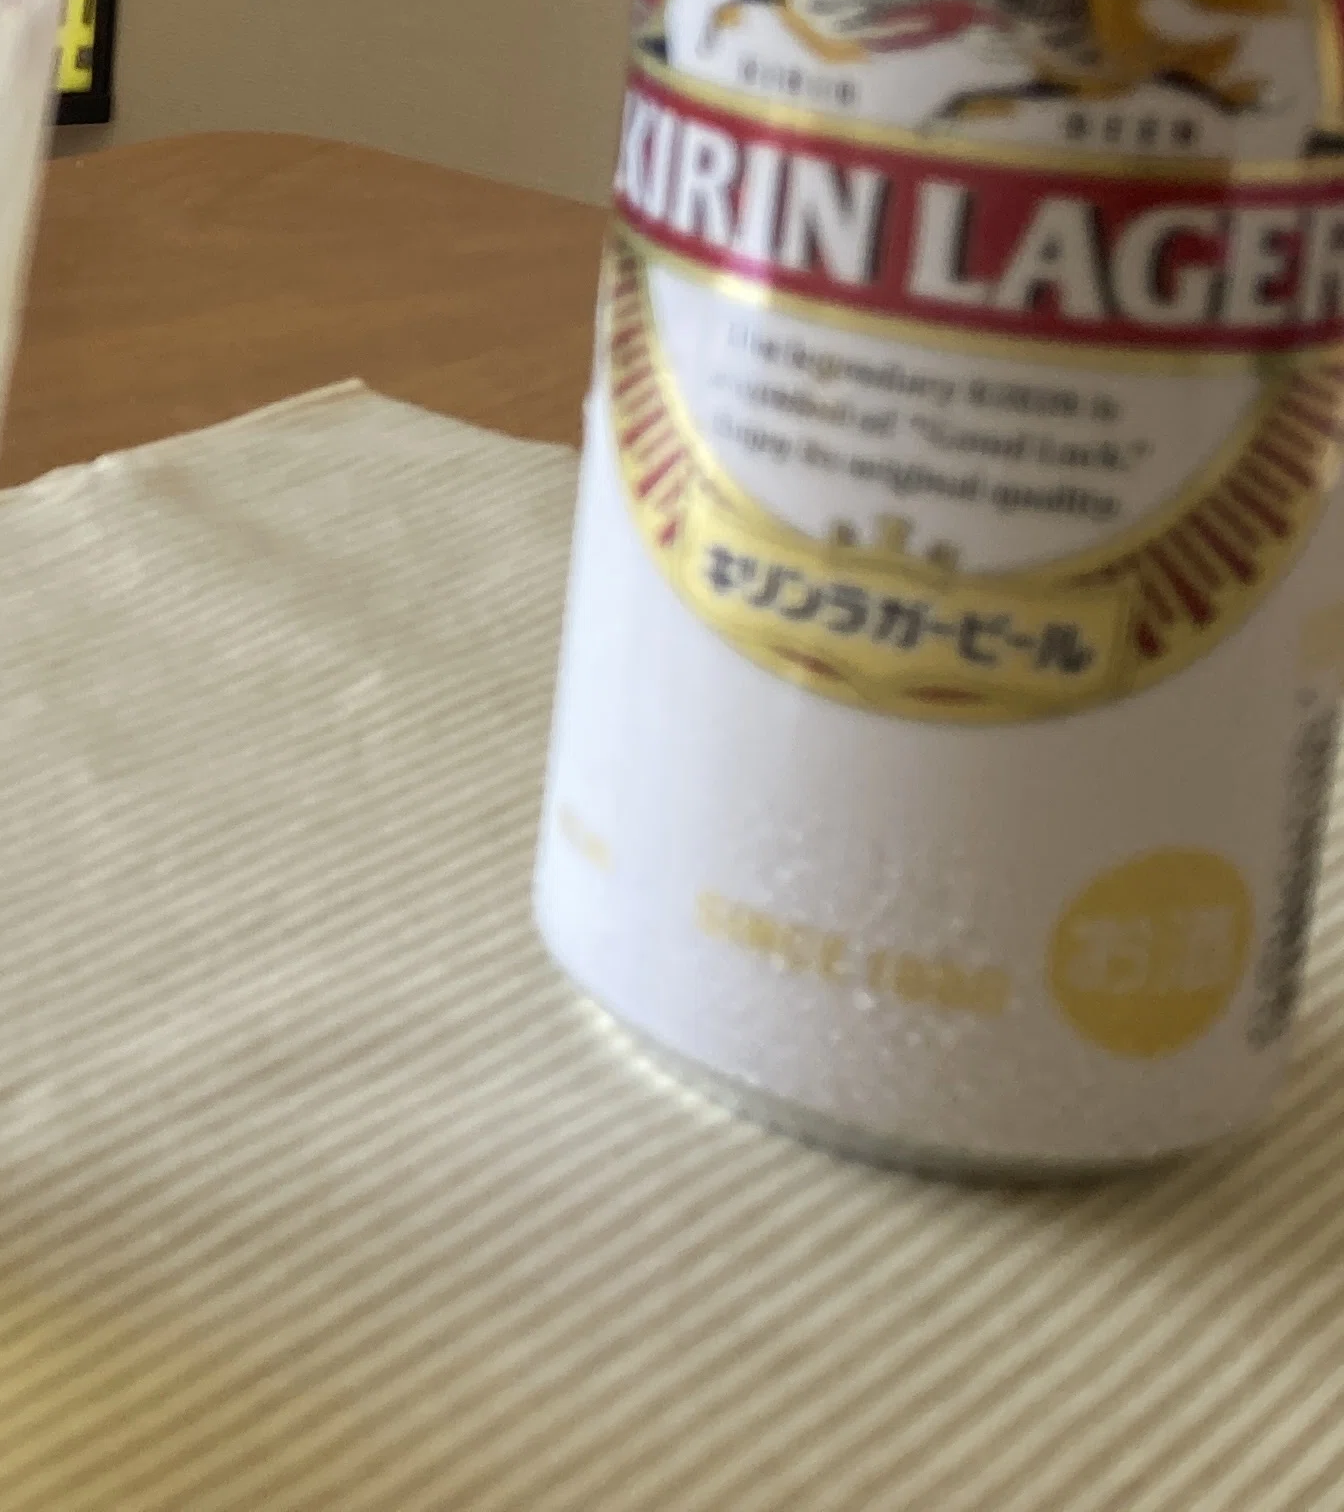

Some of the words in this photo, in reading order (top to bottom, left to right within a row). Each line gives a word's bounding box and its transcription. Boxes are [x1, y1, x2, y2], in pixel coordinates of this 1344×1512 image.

[701, 544, 1095, 676] キリンラガービール
